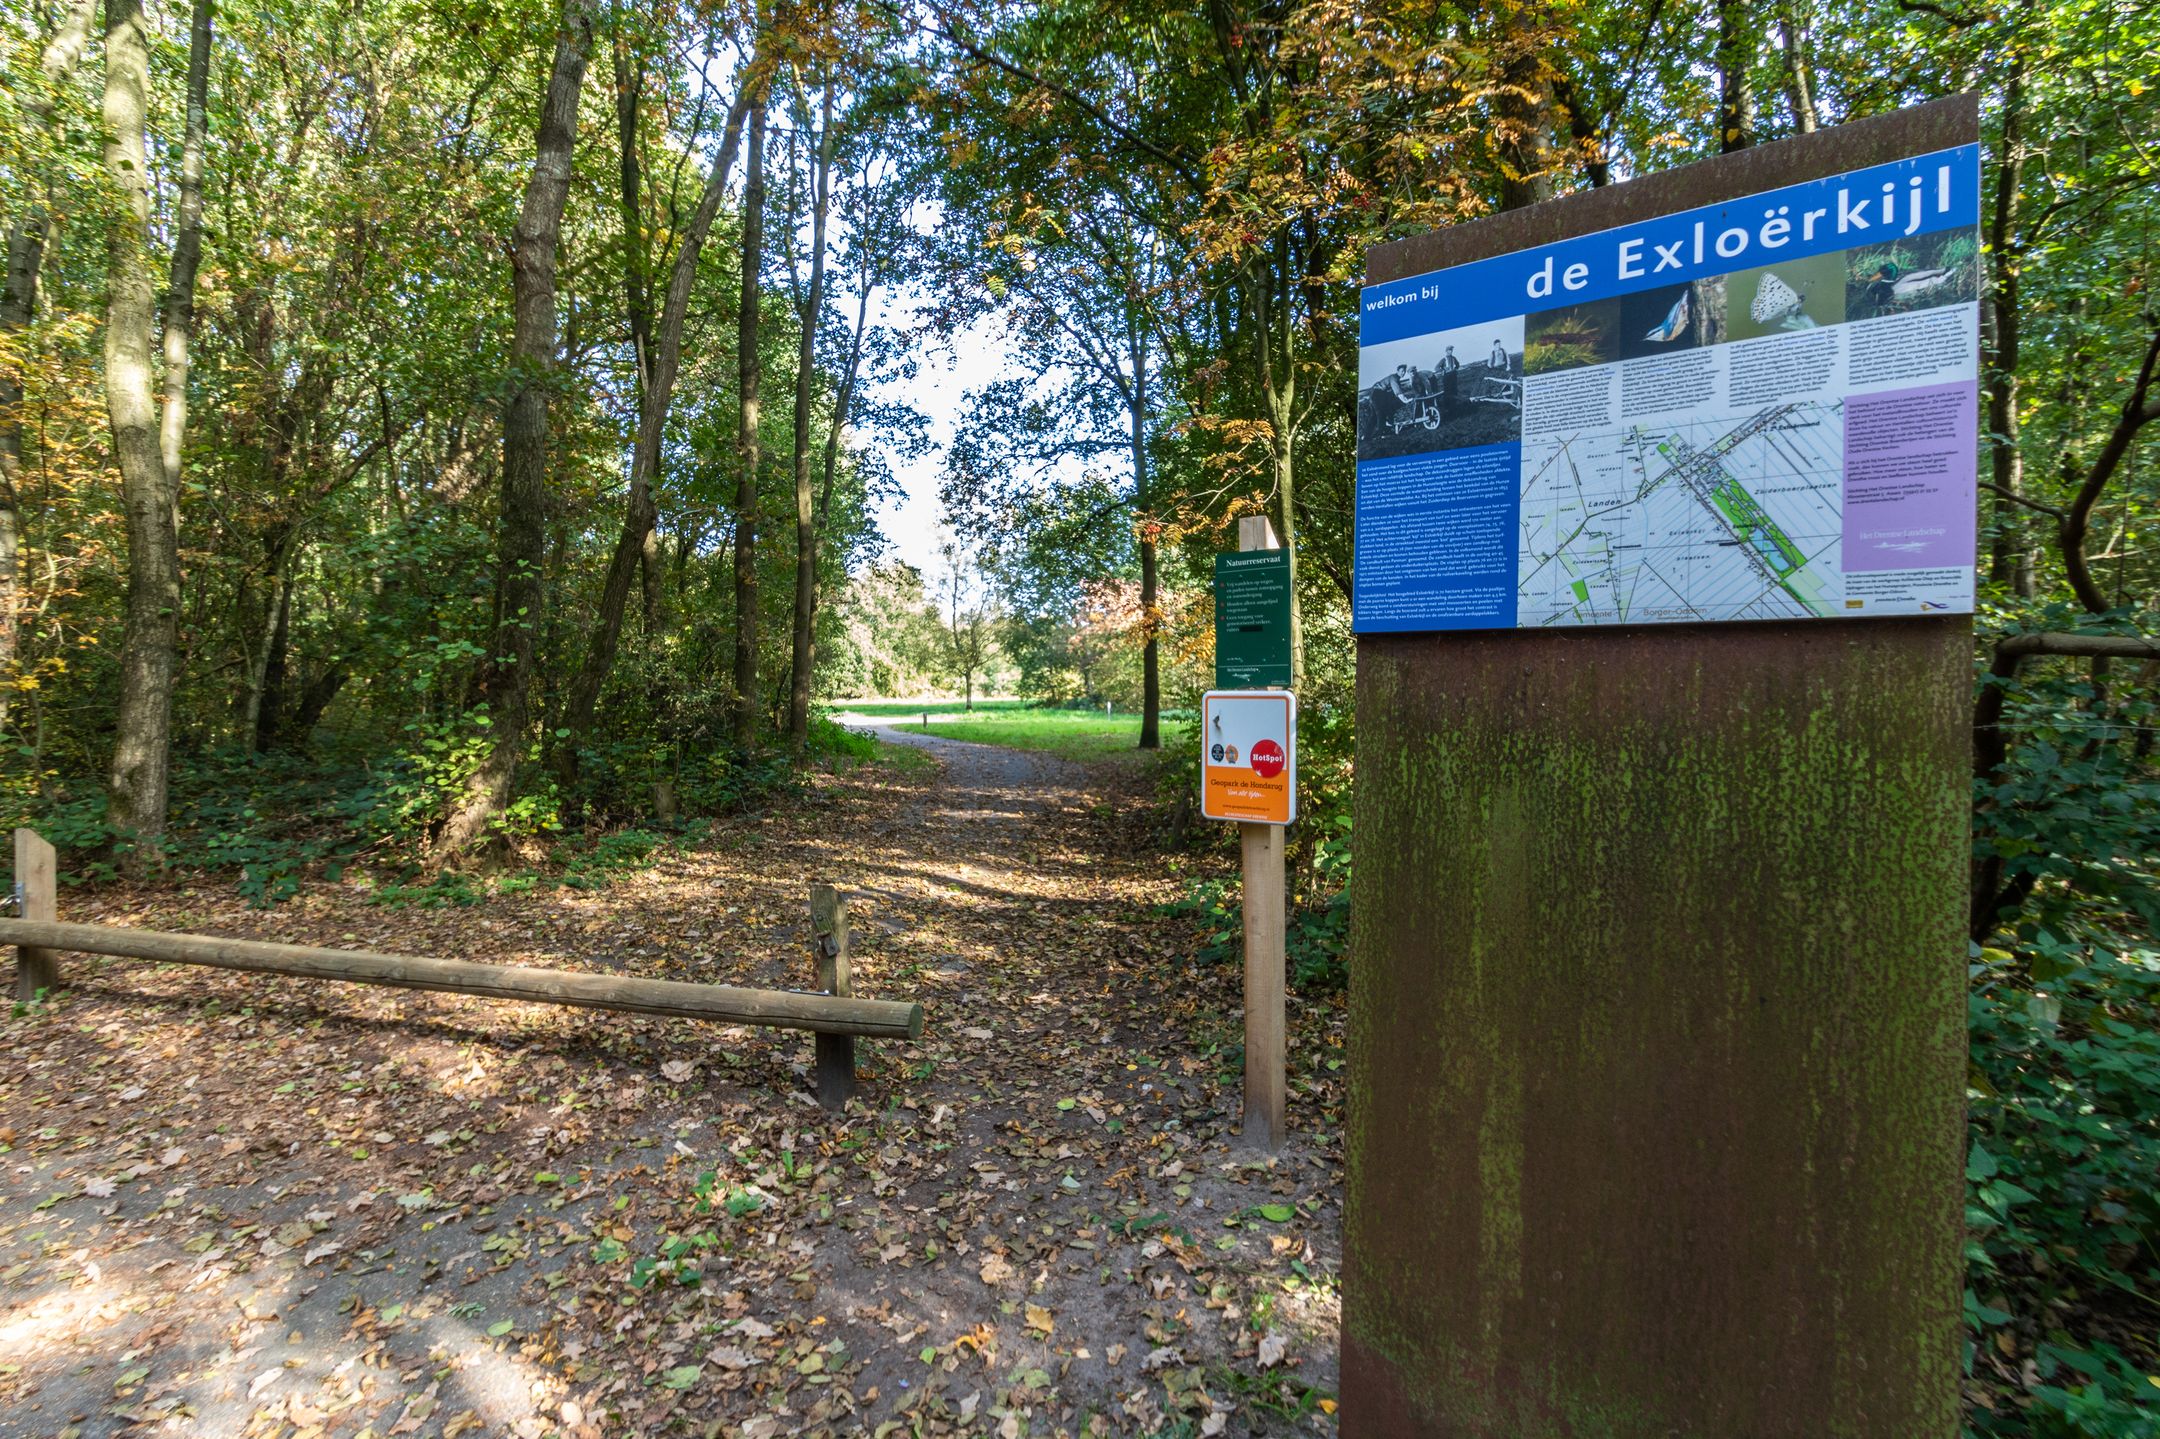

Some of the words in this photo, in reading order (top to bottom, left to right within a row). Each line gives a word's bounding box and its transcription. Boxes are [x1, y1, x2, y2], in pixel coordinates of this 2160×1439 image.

[1526, 256, 1589, 299] de
[1618, 165, 1950, 281] Exloërkijl
[1366, 292, 1417, 311] welkom
[1421, 285, 1439, 300] bij
[1588, 499, 1622, 508] Landen
[1226, 556, 1281, 567] Natuurreservaat
[1252, 753, 1283, 764] HotSpot
[1210, 779, 1239, 788] Geopark
